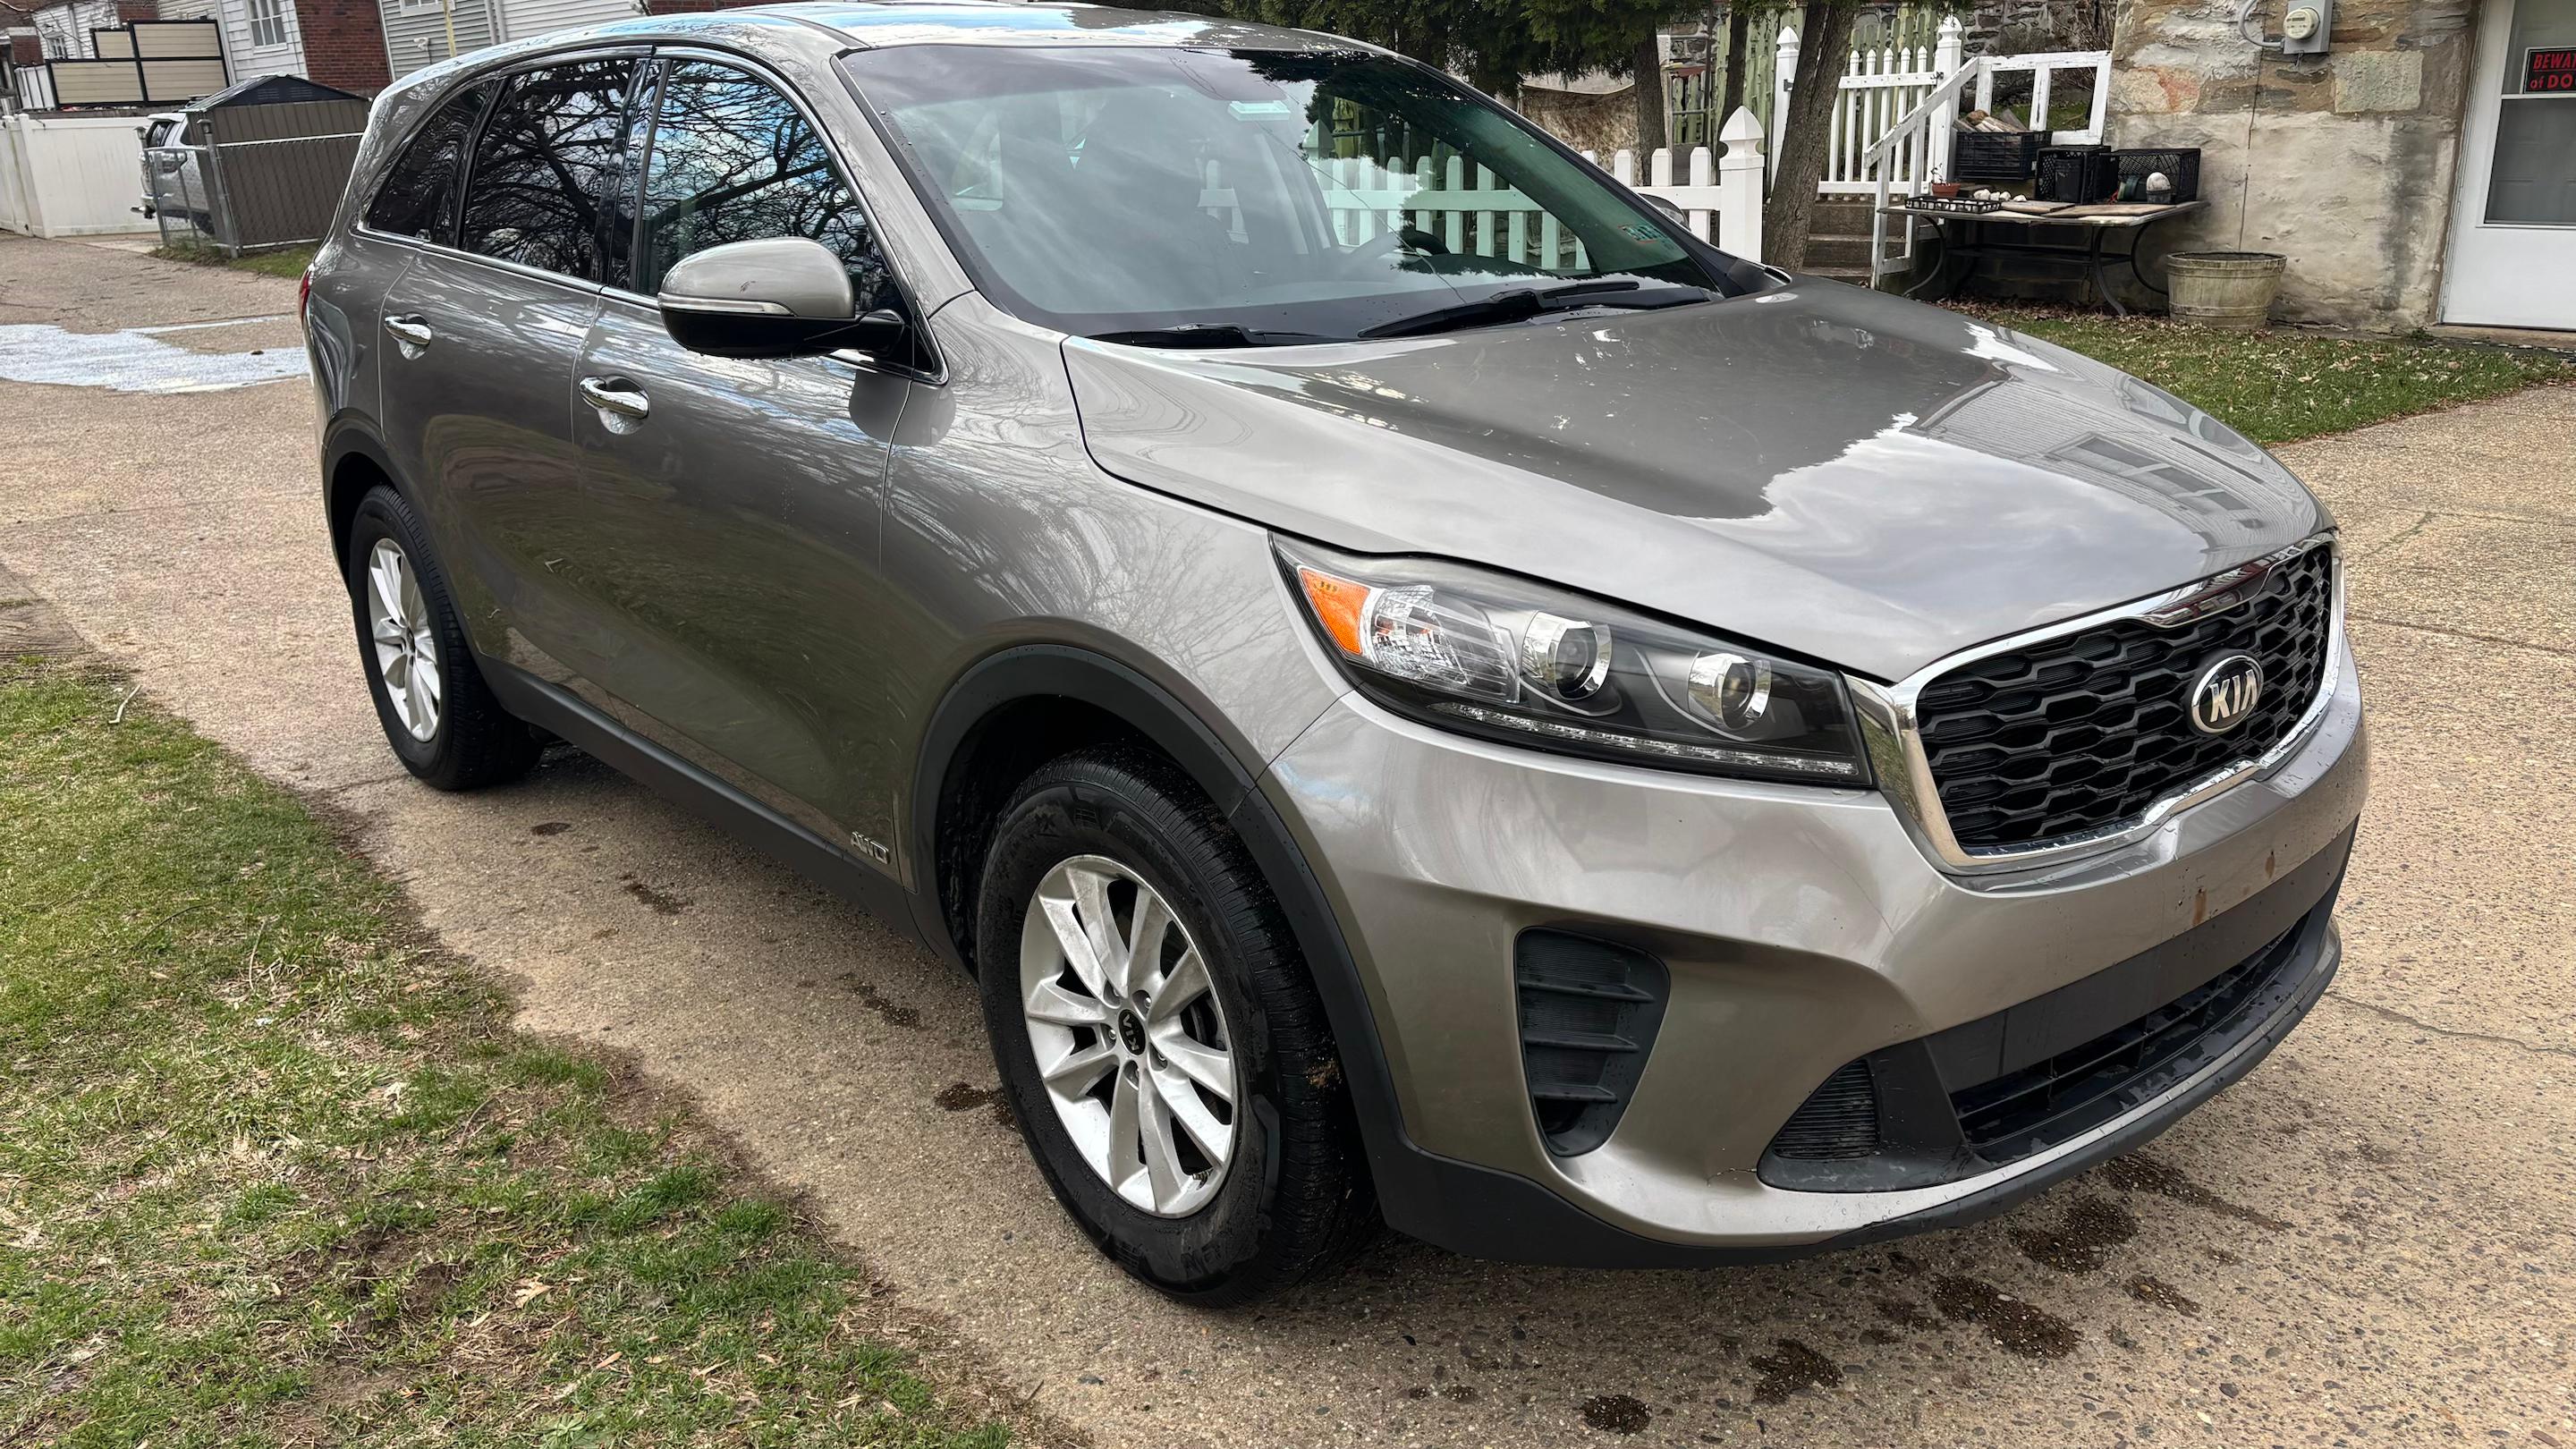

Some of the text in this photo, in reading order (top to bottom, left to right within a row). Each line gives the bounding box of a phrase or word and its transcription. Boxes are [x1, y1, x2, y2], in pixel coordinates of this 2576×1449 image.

[2529, 73, 2576, 89] of DO
[2209, 669, 2258, 723] KIA
[851, 831, 889, 865] AWD
[1123, 1013, 1140, 1051] KIA
